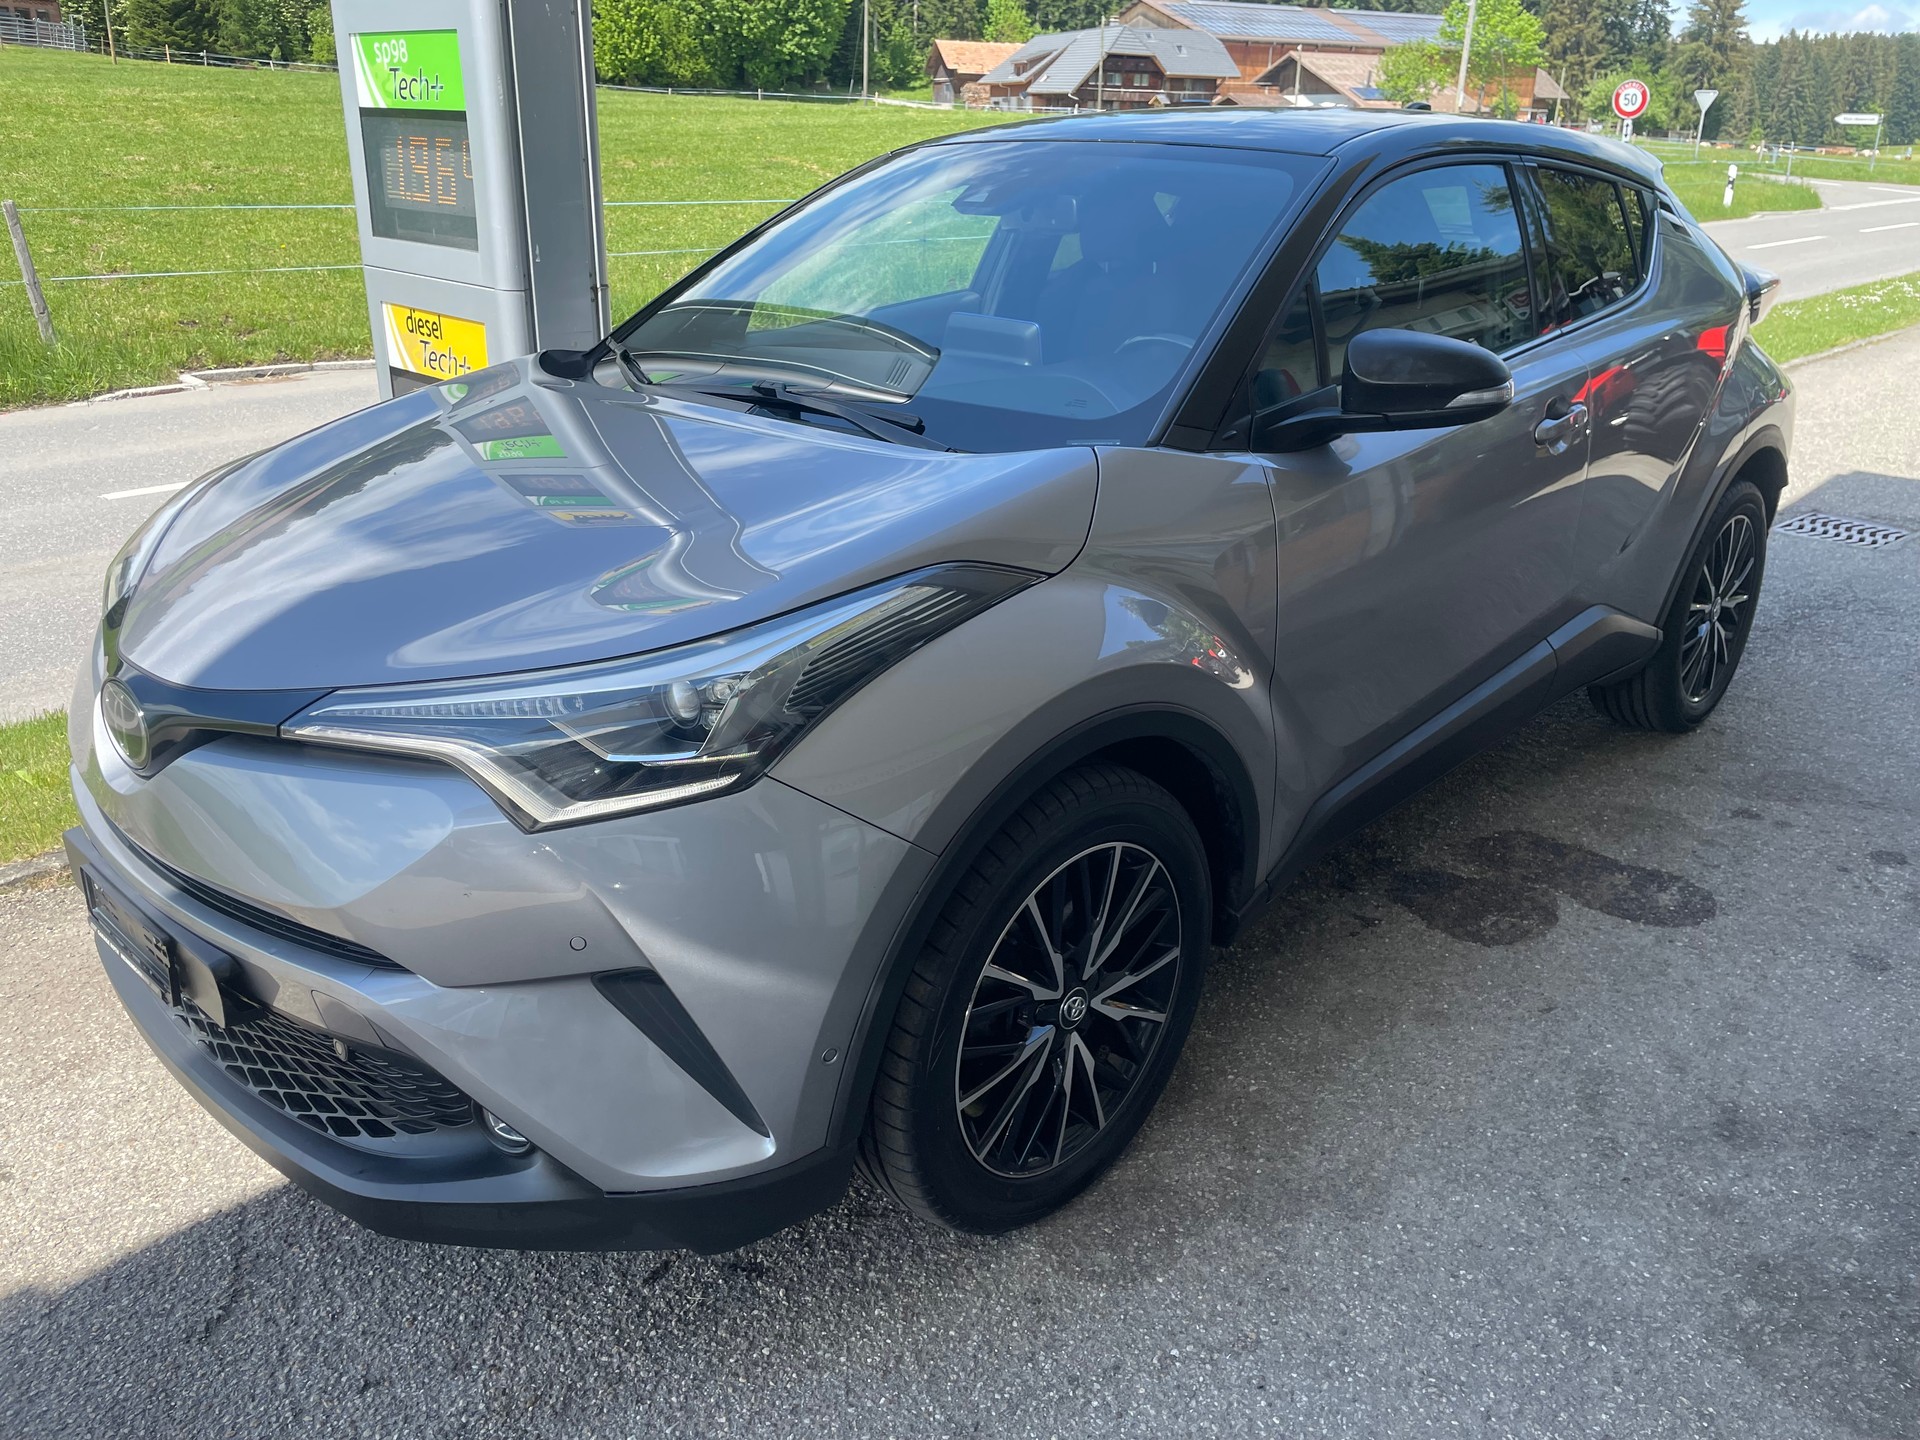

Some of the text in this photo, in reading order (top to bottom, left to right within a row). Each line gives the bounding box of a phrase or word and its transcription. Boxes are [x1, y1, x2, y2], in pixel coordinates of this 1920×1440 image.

[373, 38, 409, 70] sp98
[388, 67, 444, 101] Tech+
[1623, 92, 1638, 107] 50
[405, 308, 443, 340] diesel
[419, 339, 471, 376] Tech+
